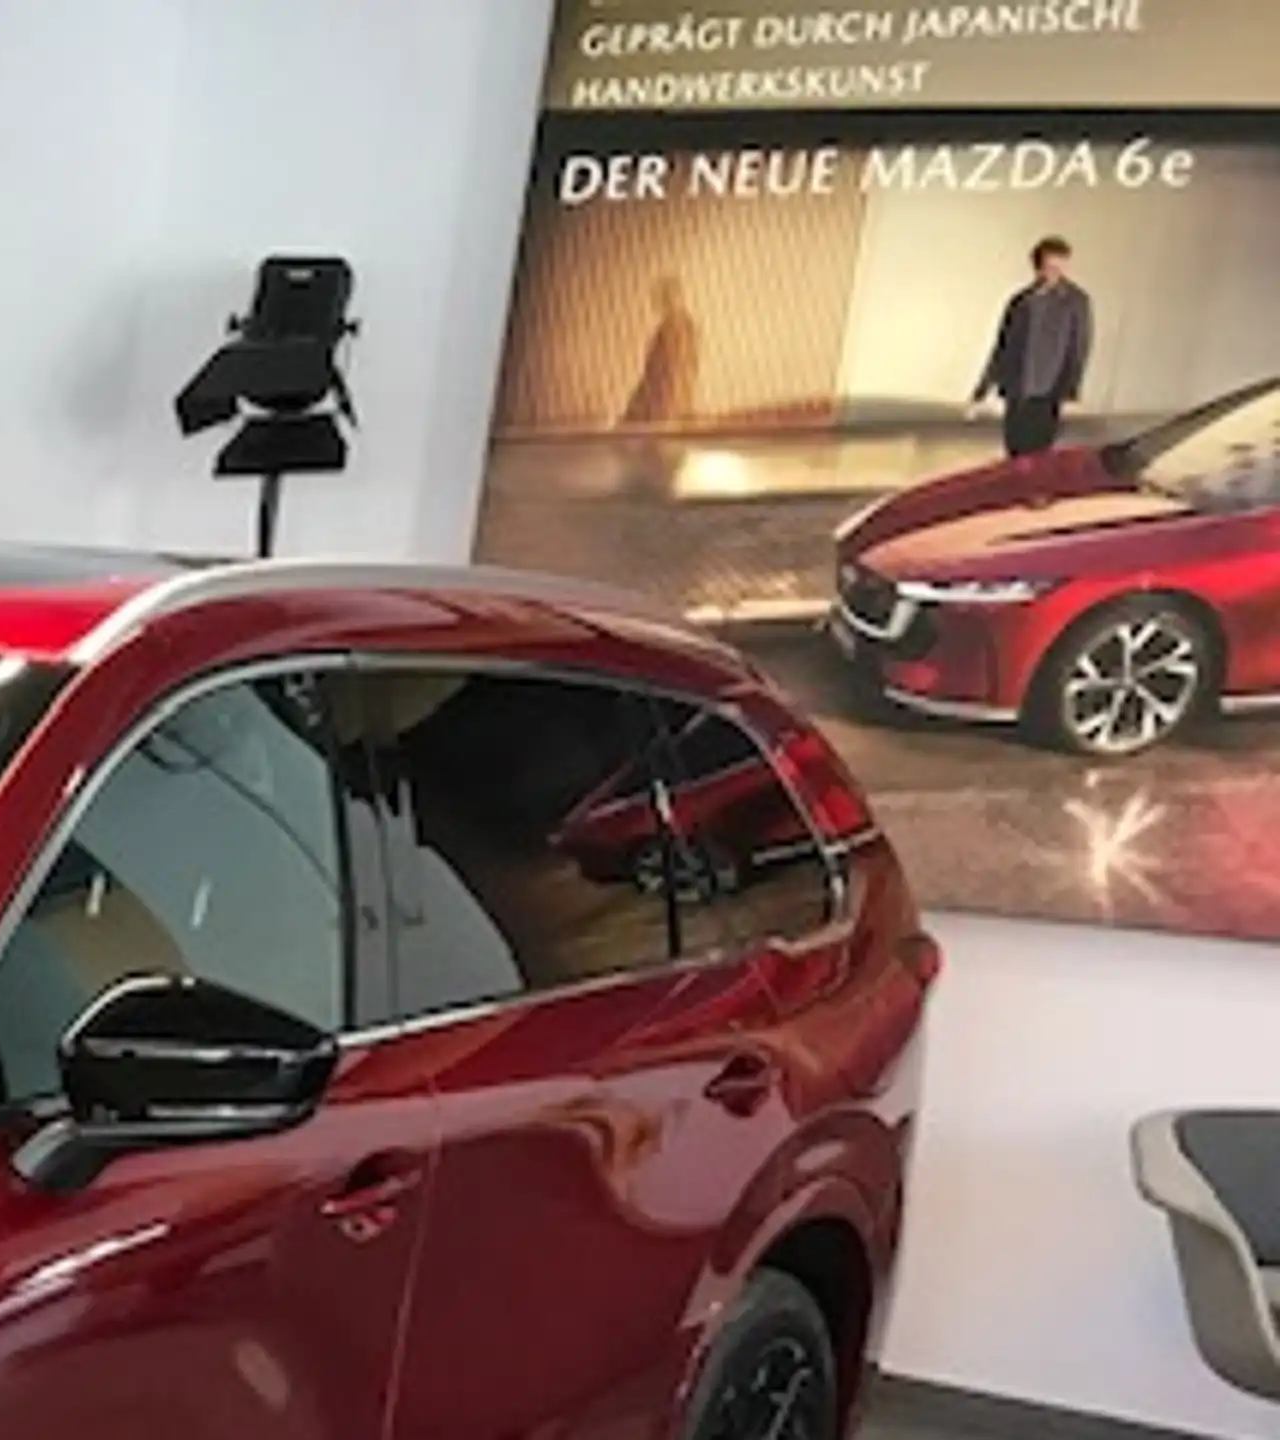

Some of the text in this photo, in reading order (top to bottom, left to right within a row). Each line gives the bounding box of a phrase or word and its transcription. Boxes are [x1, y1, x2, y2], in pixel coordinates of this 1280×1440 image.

[580, 0, 1142, 57] GEPRÄGT DURCH JAPANISCHE
[571, 60, 932, 108] HANDWERKSKUNST
[559, 136, 1195, 203] DER NEUE MAZDA 6e
